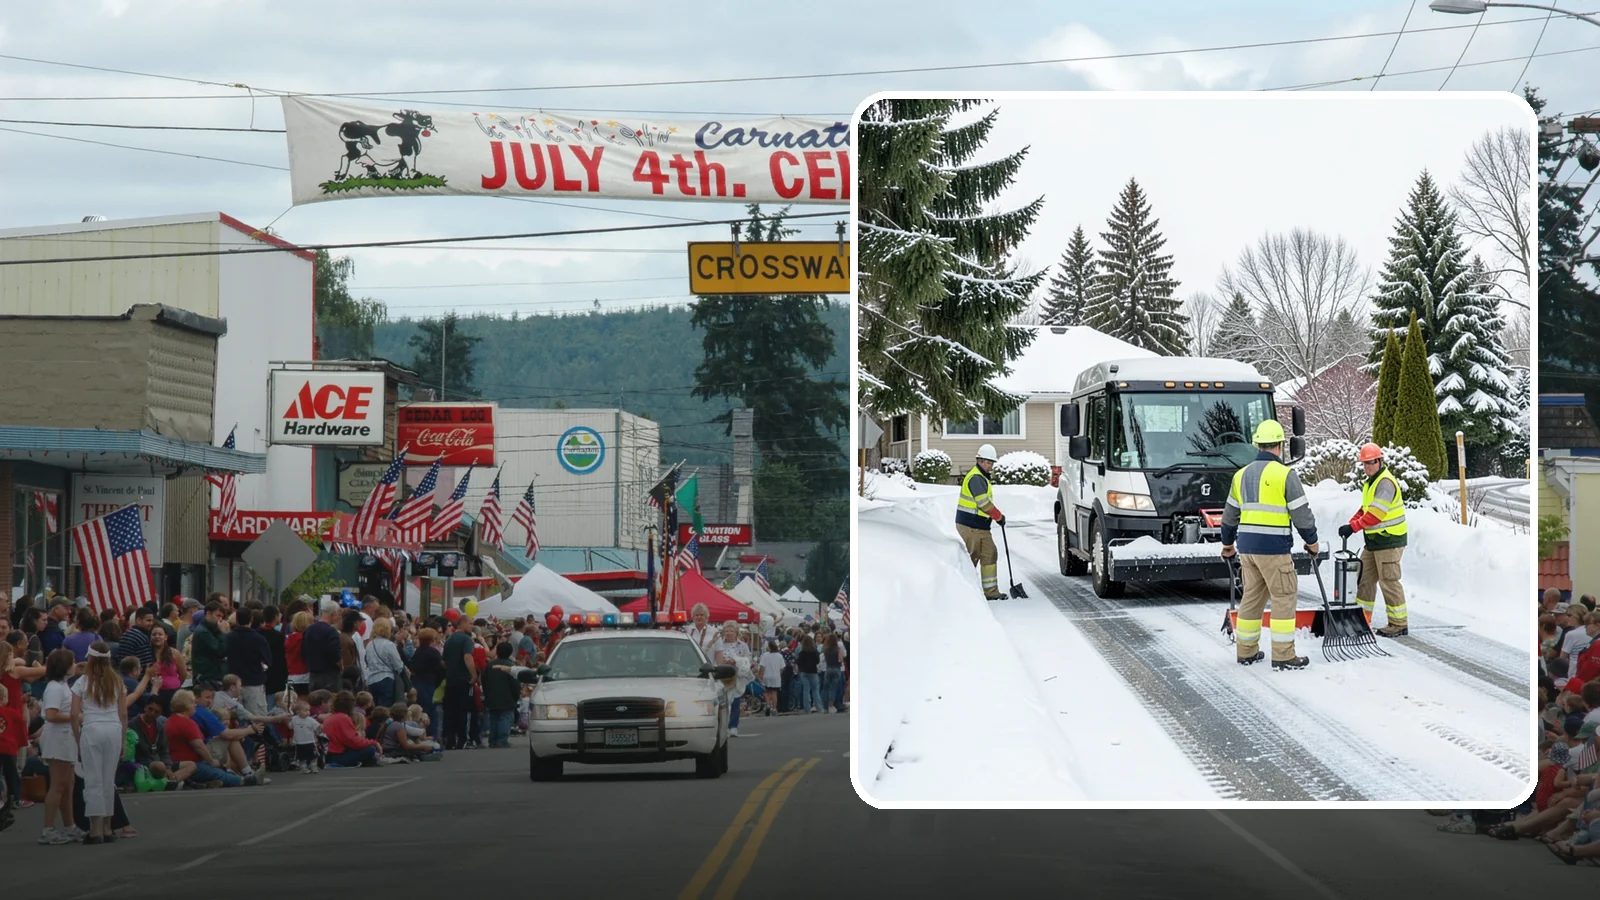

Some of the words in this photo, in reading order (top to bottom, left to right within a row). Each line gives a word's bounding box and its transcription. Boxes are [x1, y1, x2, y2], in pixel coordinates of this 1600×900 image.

[481, 141, 605, 192] JULY
[632, 150, 746, 198] 4th.
[696, 254, 850, 280] CROSSWA
[282, 379, 374, 420] ACE
[405, 409, 453, 422] CEDAR
[283, 421, 371, 436] Hardware
[416, 428, 477, 447] Coca-Cola
[353, 467, 385, 481] Simpl
[95, 484, 124, 495] Vincent
[126, 486, 136, 495] de
[137, 486, 155, 495] Paul
[688, 526, 741, 535] CRNATION
[699, 535, 730, 543] GLASS
